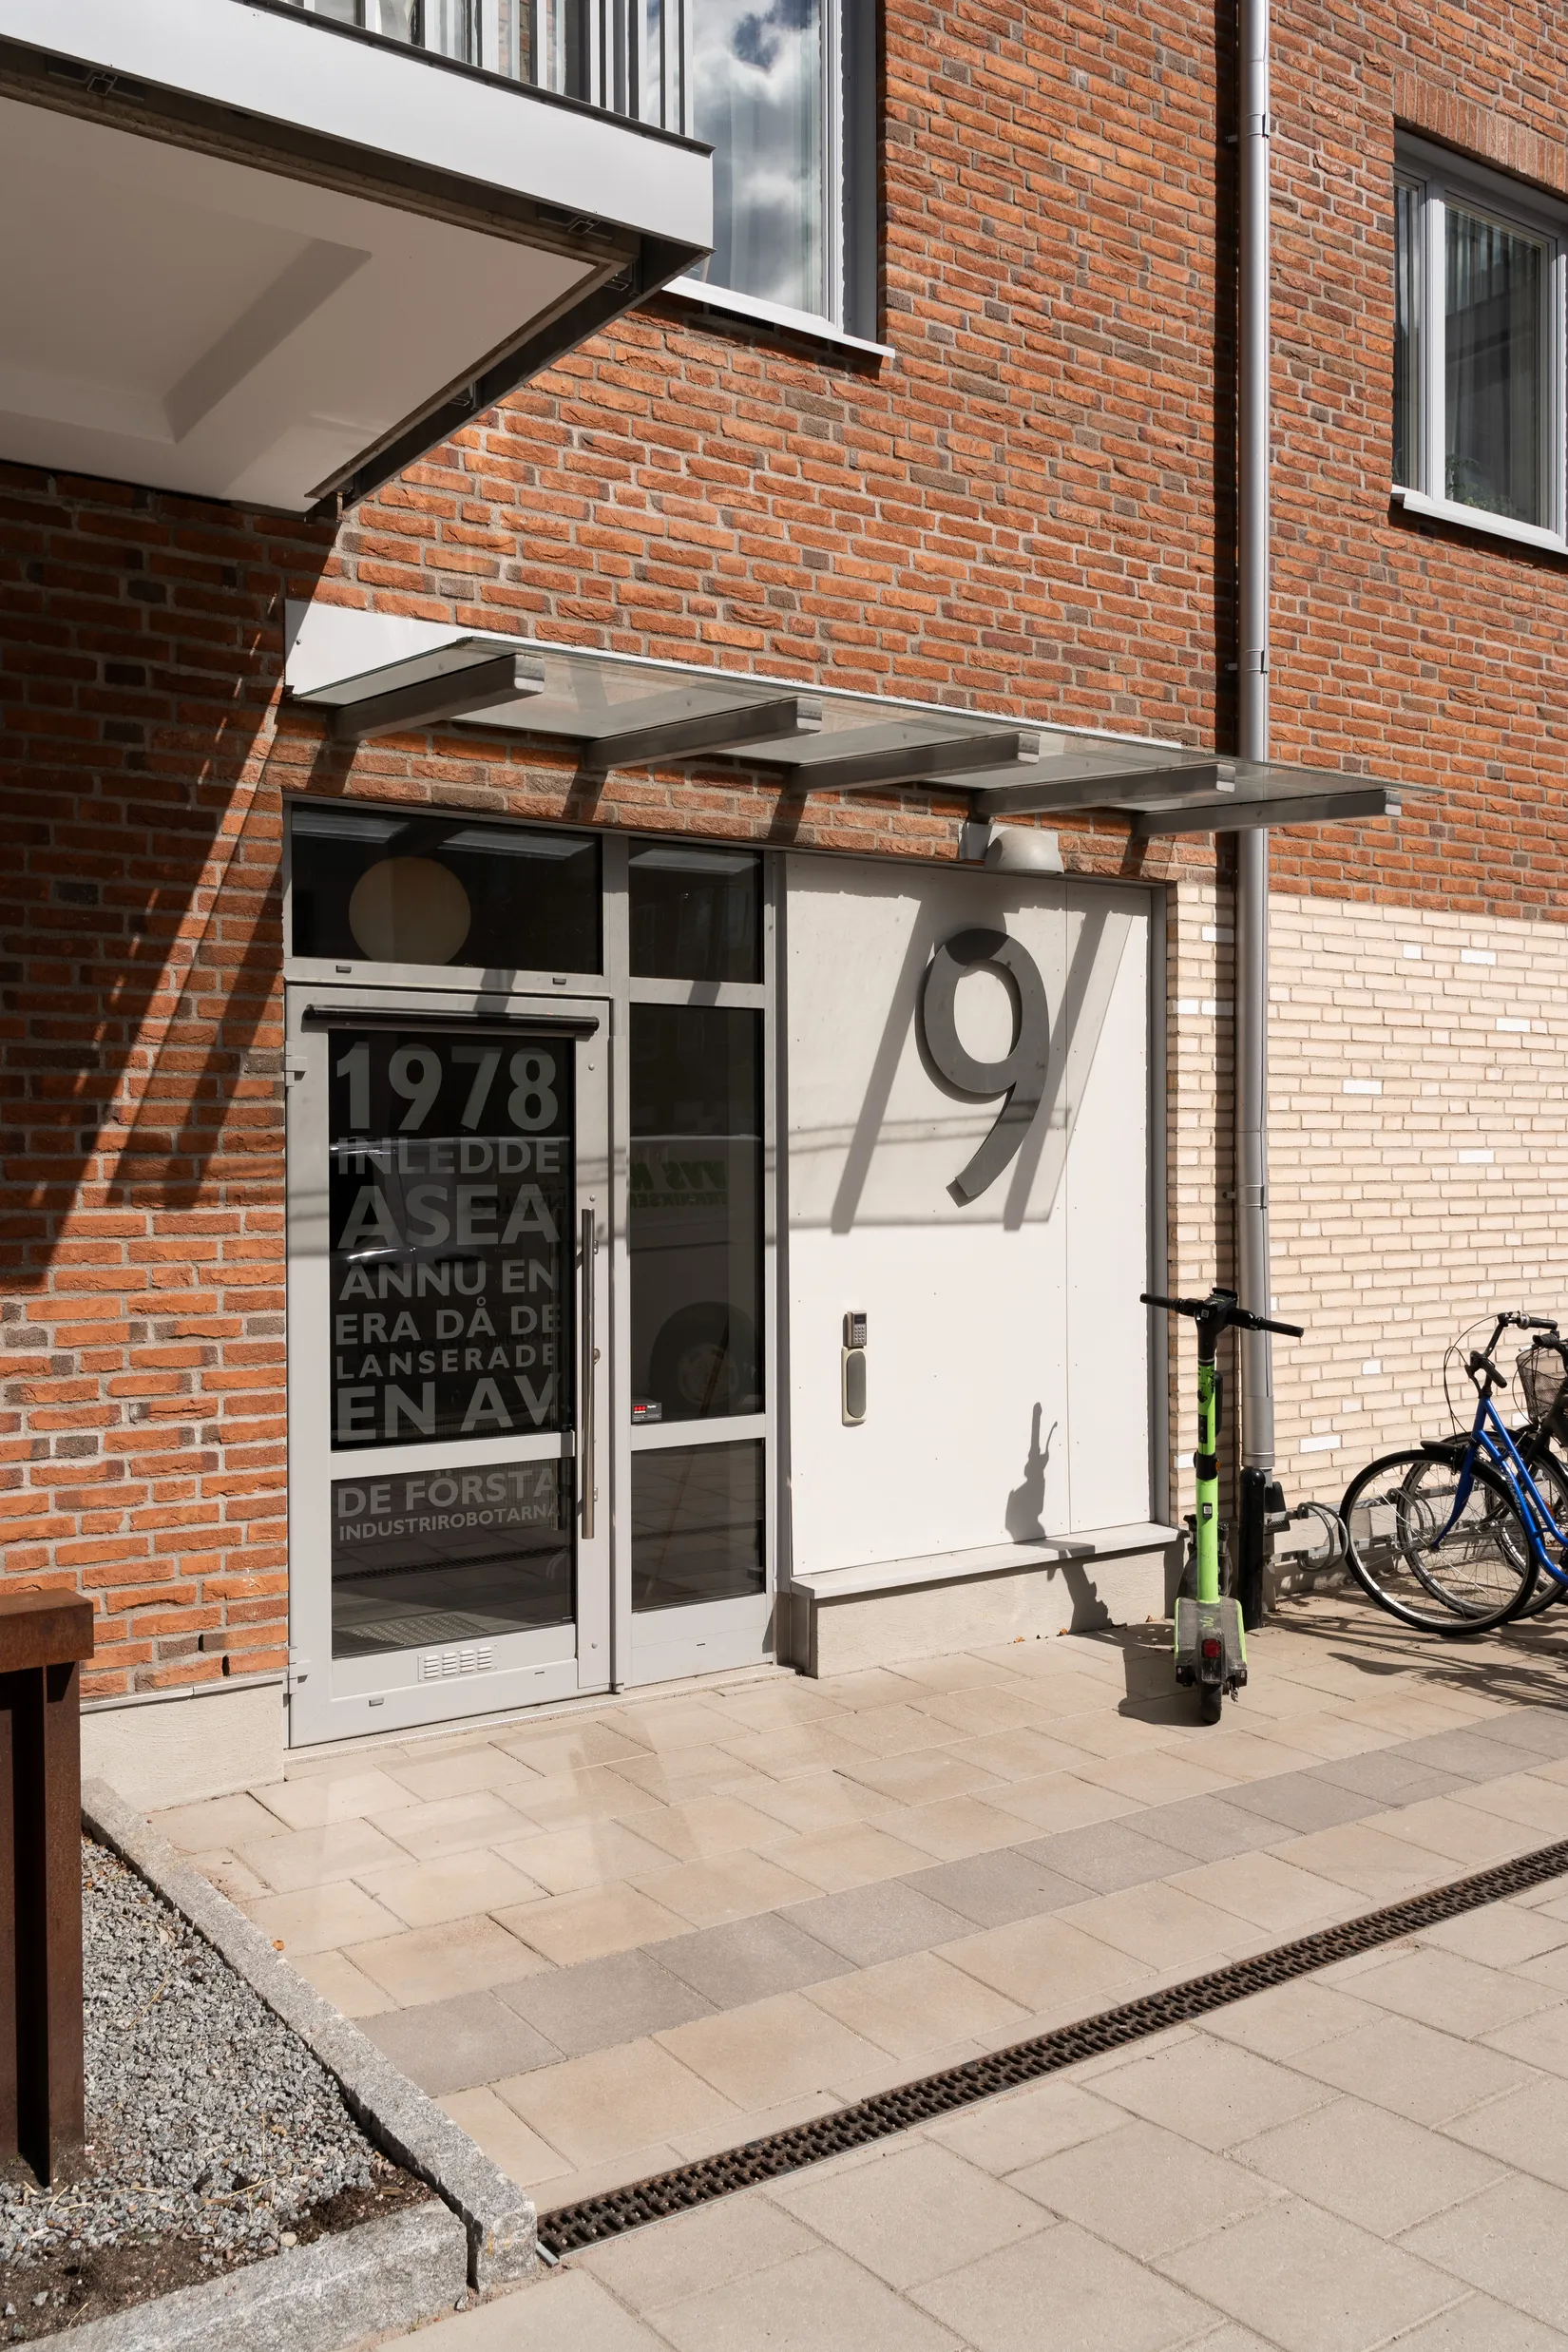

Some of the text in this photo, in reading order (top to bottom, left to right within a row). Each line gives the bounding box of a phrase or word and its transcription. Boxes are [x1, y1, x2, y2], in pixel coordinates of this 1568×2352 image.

[336, 1042, 559, 1131] 1978
[924, 927, 1049, 1197] 9
[337, 1137, 561, 1175] INLEDDE
[337, 1183, 561, 1249] ASEA
[502, 1259, 559, 1293] EN
[335, 1310, 421, 1346] ERA
[436, 1296, 497, 1340] DÅ
[510, 1304, 562, 1335] DE
[335, 1343, 556, 1380] LANSERADE
[336, 1372, 562, 1443] EN AV
[337, 1467, 561, 1519] DE FÖRSTA
